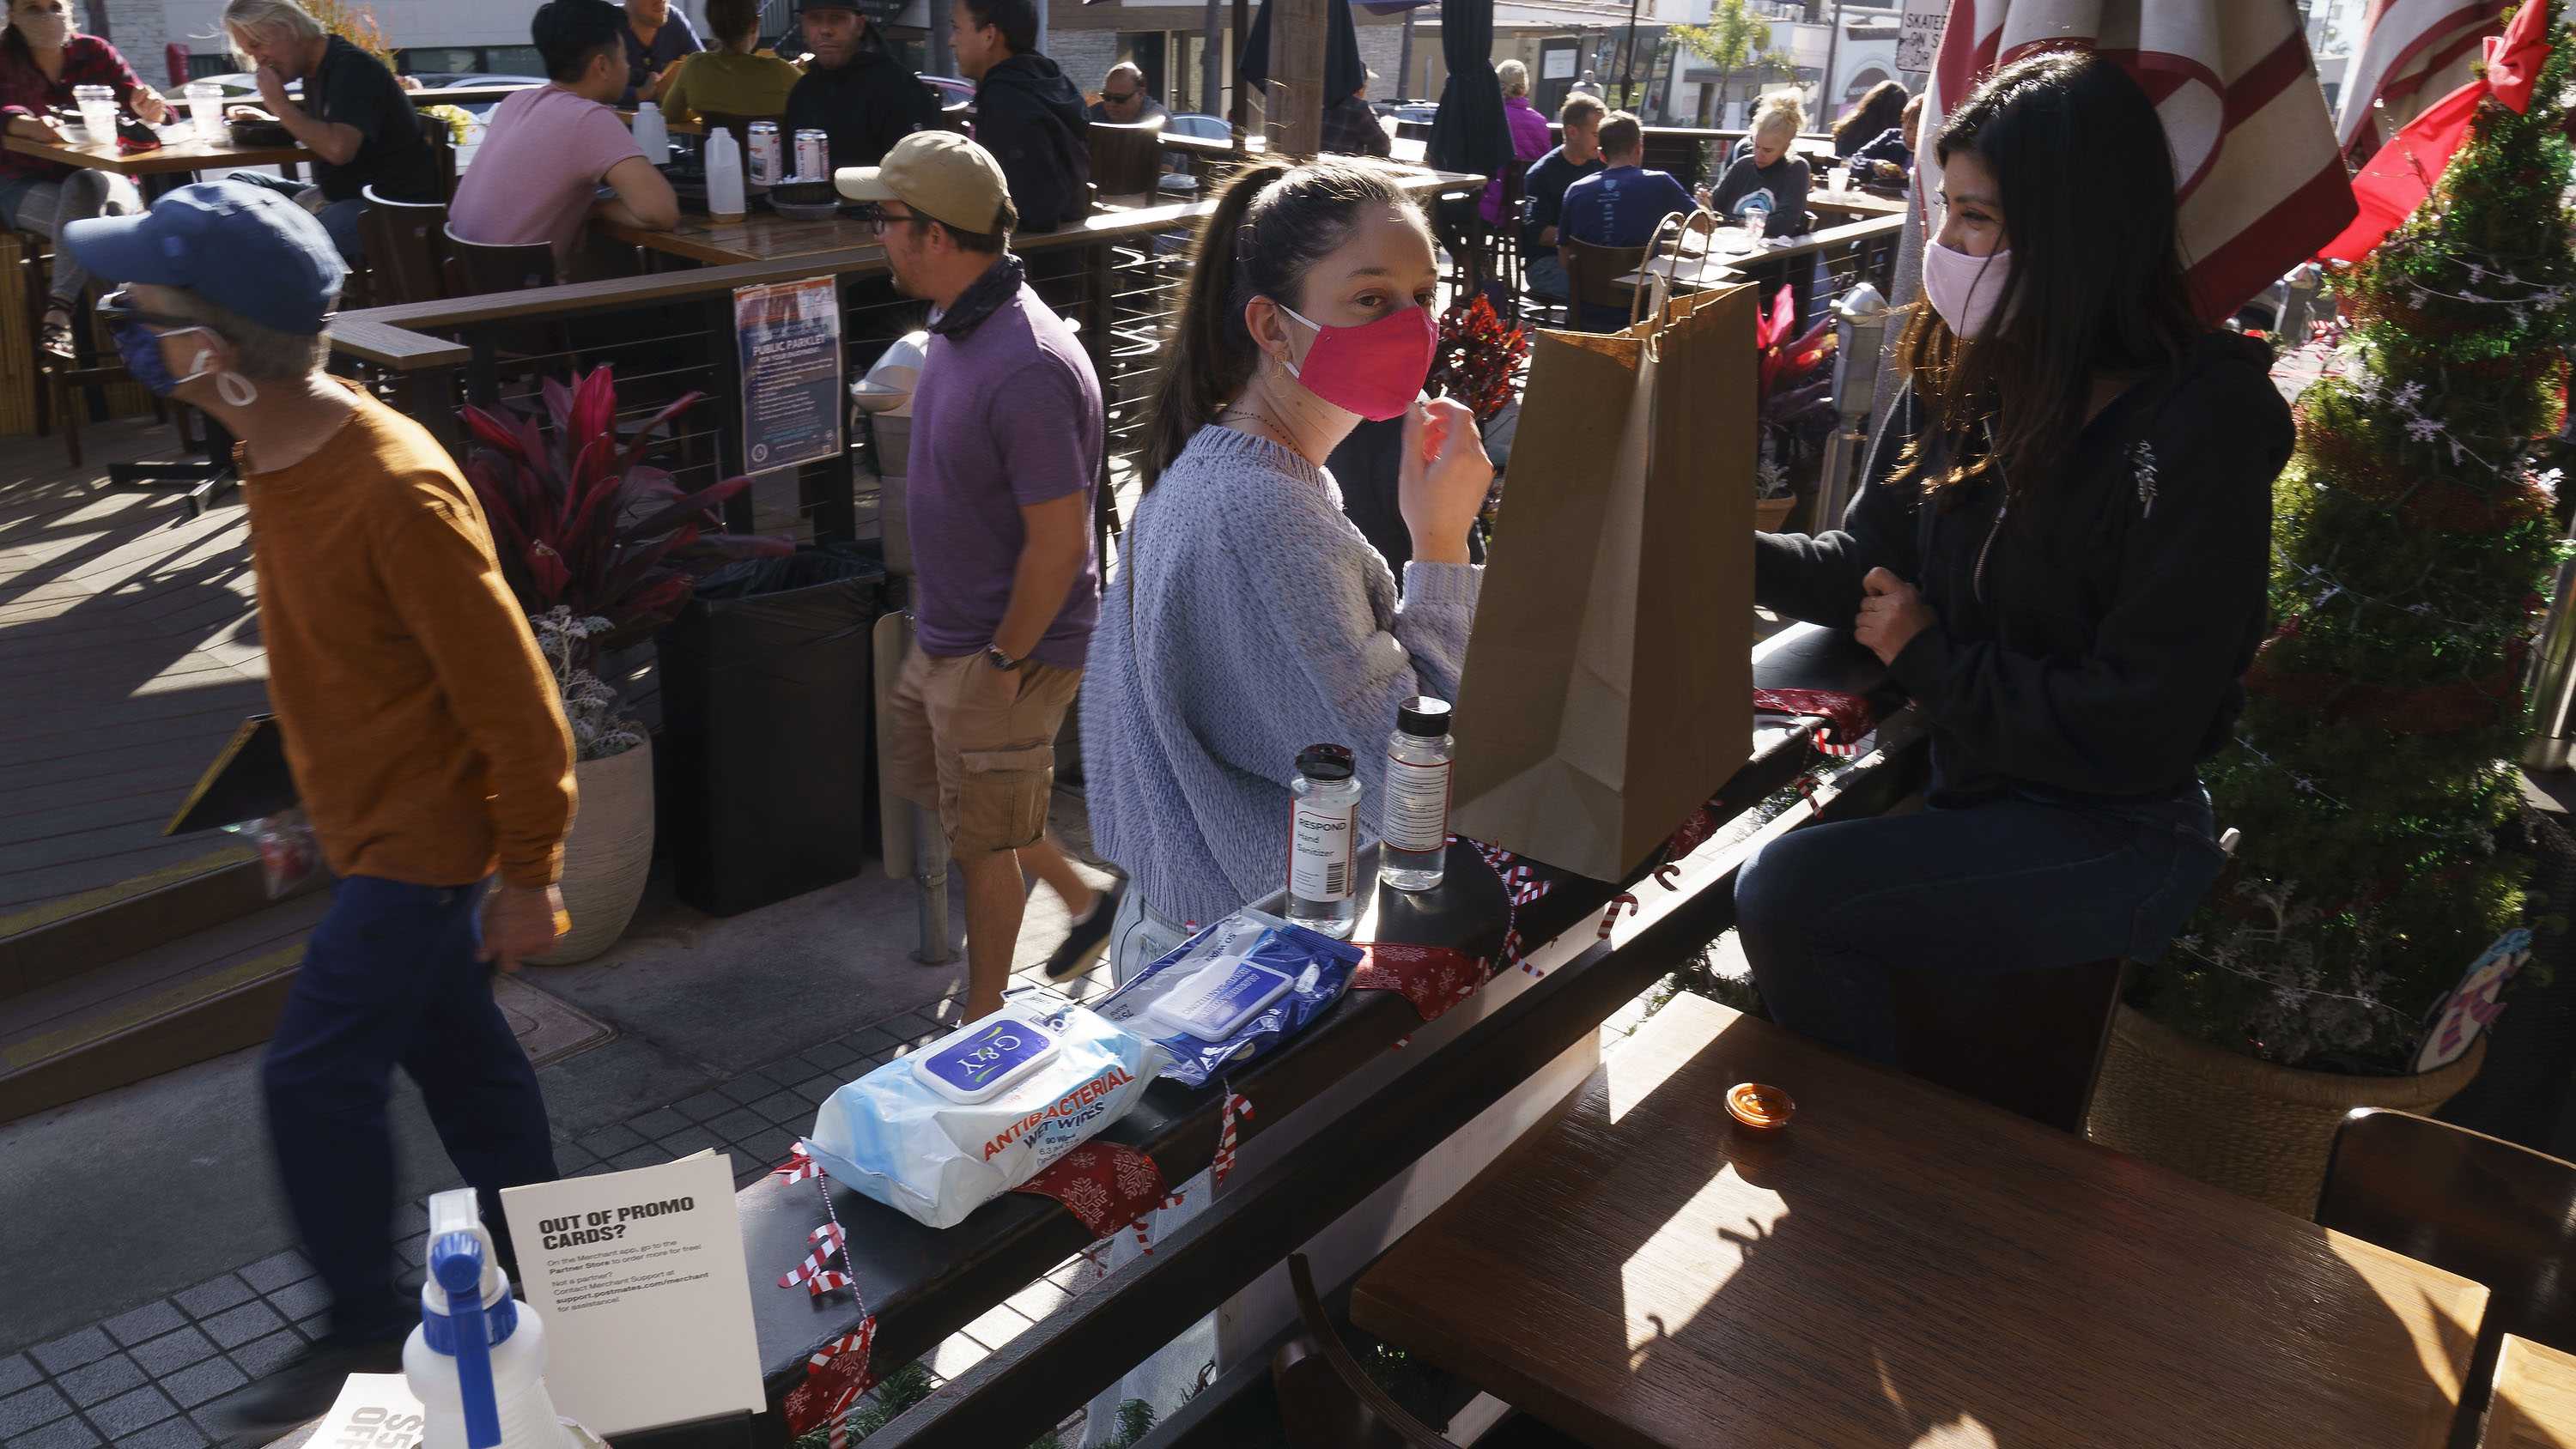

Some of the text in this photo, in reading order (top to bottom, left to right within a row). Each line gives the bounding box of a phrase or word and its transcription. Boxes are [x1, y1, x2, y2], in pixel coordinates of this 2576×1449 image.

[752, 333, 825, 357] PUBLIC PARKLET
[1297, 831, 1319, 844] Hand
[1298, 817, 1346, 832] RESPOND
[1297, 843, 1334, 857] Sanitizer
[957, 1035, 1022, 1076] G&Y
[983, 1066, 1136, 1161] ANTIBACTERIAL
[1023, 1120, 1053, 1149] WET
[1057, 1101, 1105, 1130] WIPES
[538, 1197, 695, 1234] OUT OF PROMO
[543, 1224, 626, 1250] CARDS?
[549, 1264, 584, 1276] Partner
[586, 1259, 610, 1270] Store
[622, 1253, 645, 1263] order
[646, 1251, 668, 1259] more
[669, 1247, 681, 1256] for
[683, 1243, 702, 1252] free!
[562, 1256, 576, 1264] the
[577, 1249, 618, 1262] Merchant
[641, 1244, 651, 1252] go
[551, 1279, 568, 1288] Not
[576, 1271, 613, 1285] partner?
[553, 1284, 587, 1296] Contact
[589, 1277, 630, 1290] Merchant
[631, 1270, 665, 1284] Support
[556, 1271, 709, 1305] support.postmates.com/merchant
[557, 1296, 621, 1313] for assistance!
[337, 1407, 388, 1449] OFF
